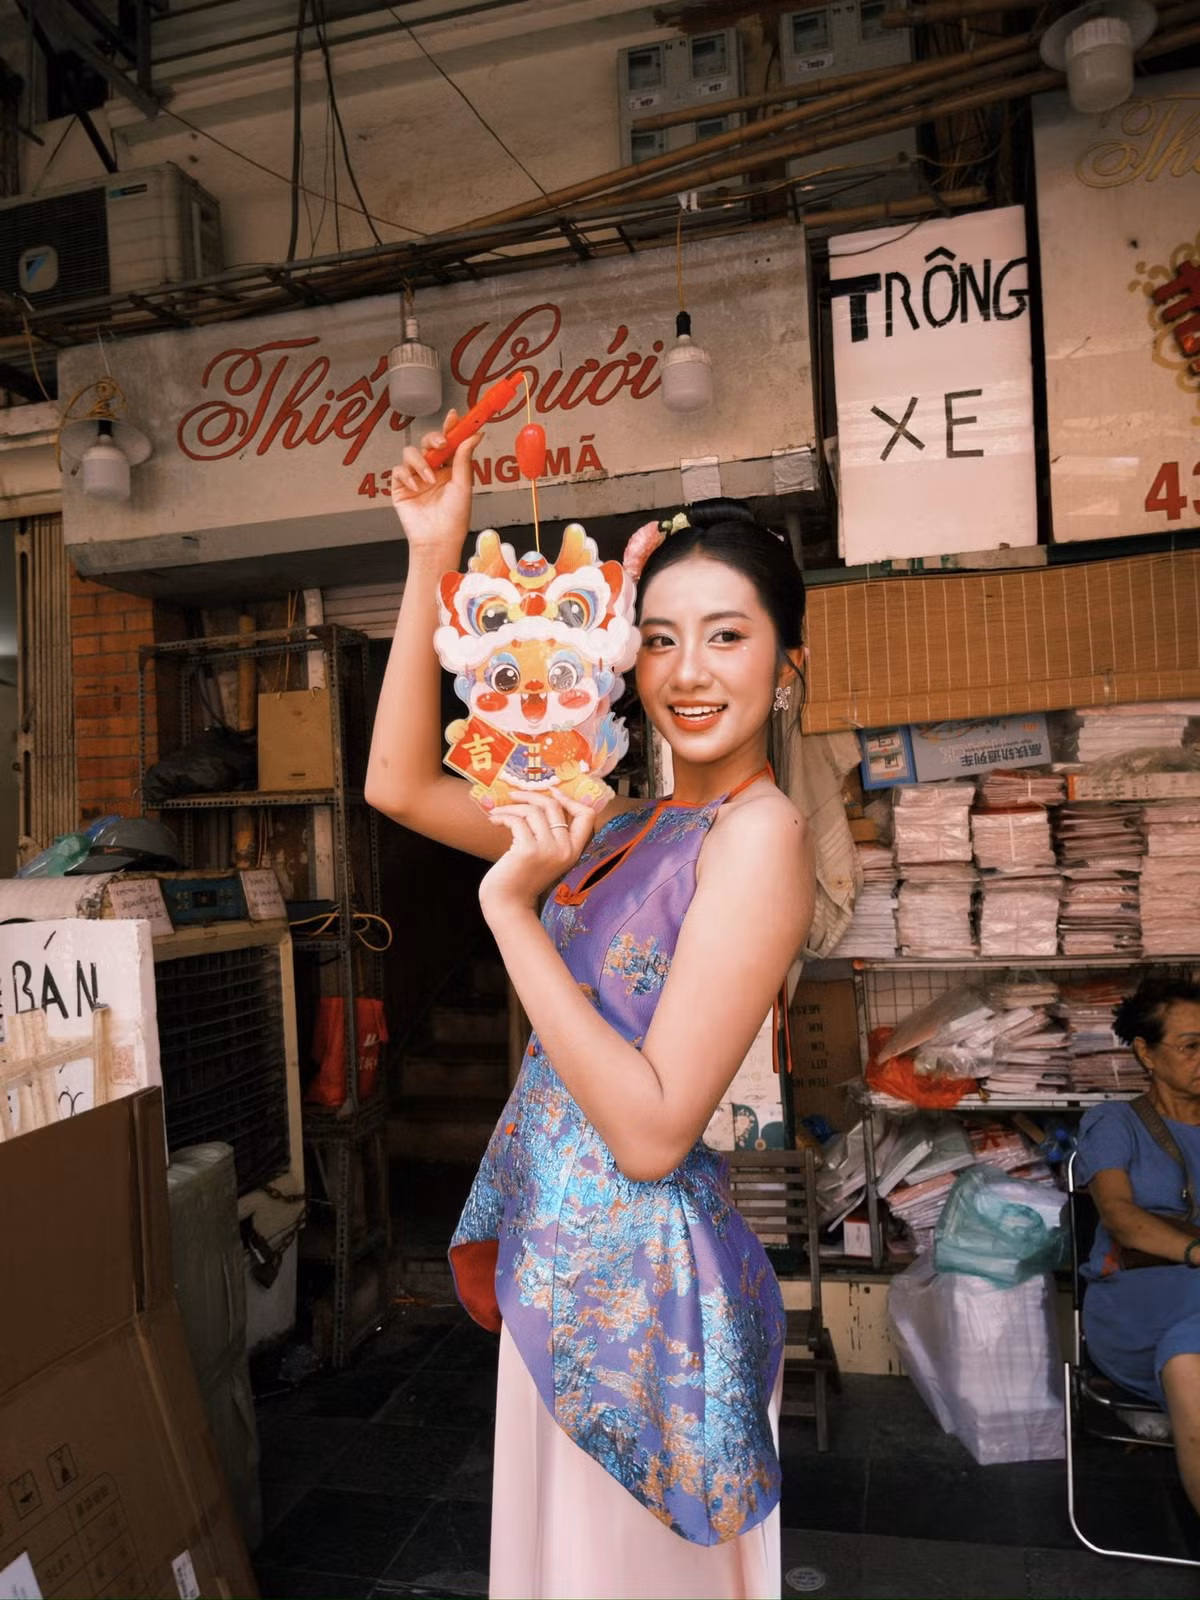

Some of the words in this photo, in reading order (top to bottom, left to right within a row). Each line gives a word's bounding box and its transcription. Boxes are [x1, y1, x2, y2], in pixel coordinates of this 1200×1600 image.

[1075, 93, 1200, 188] Th
[829, 246, 1030, 343] TRÔNG
[177, 336, 416, 466] Thiếp
[450, 302, 664, 423] Cưới
[470, 455, 521, 487] NG
[541, 434, 604, 477] MÃ
[870, 389, 984, 461] XE
[1144, 461, 1200, 521] 4
[461, 733, 496, 772] 吉
[960, 743, 1042, 767] 高铁轨道列车
[12, 930, 103, 1019] BÁN
